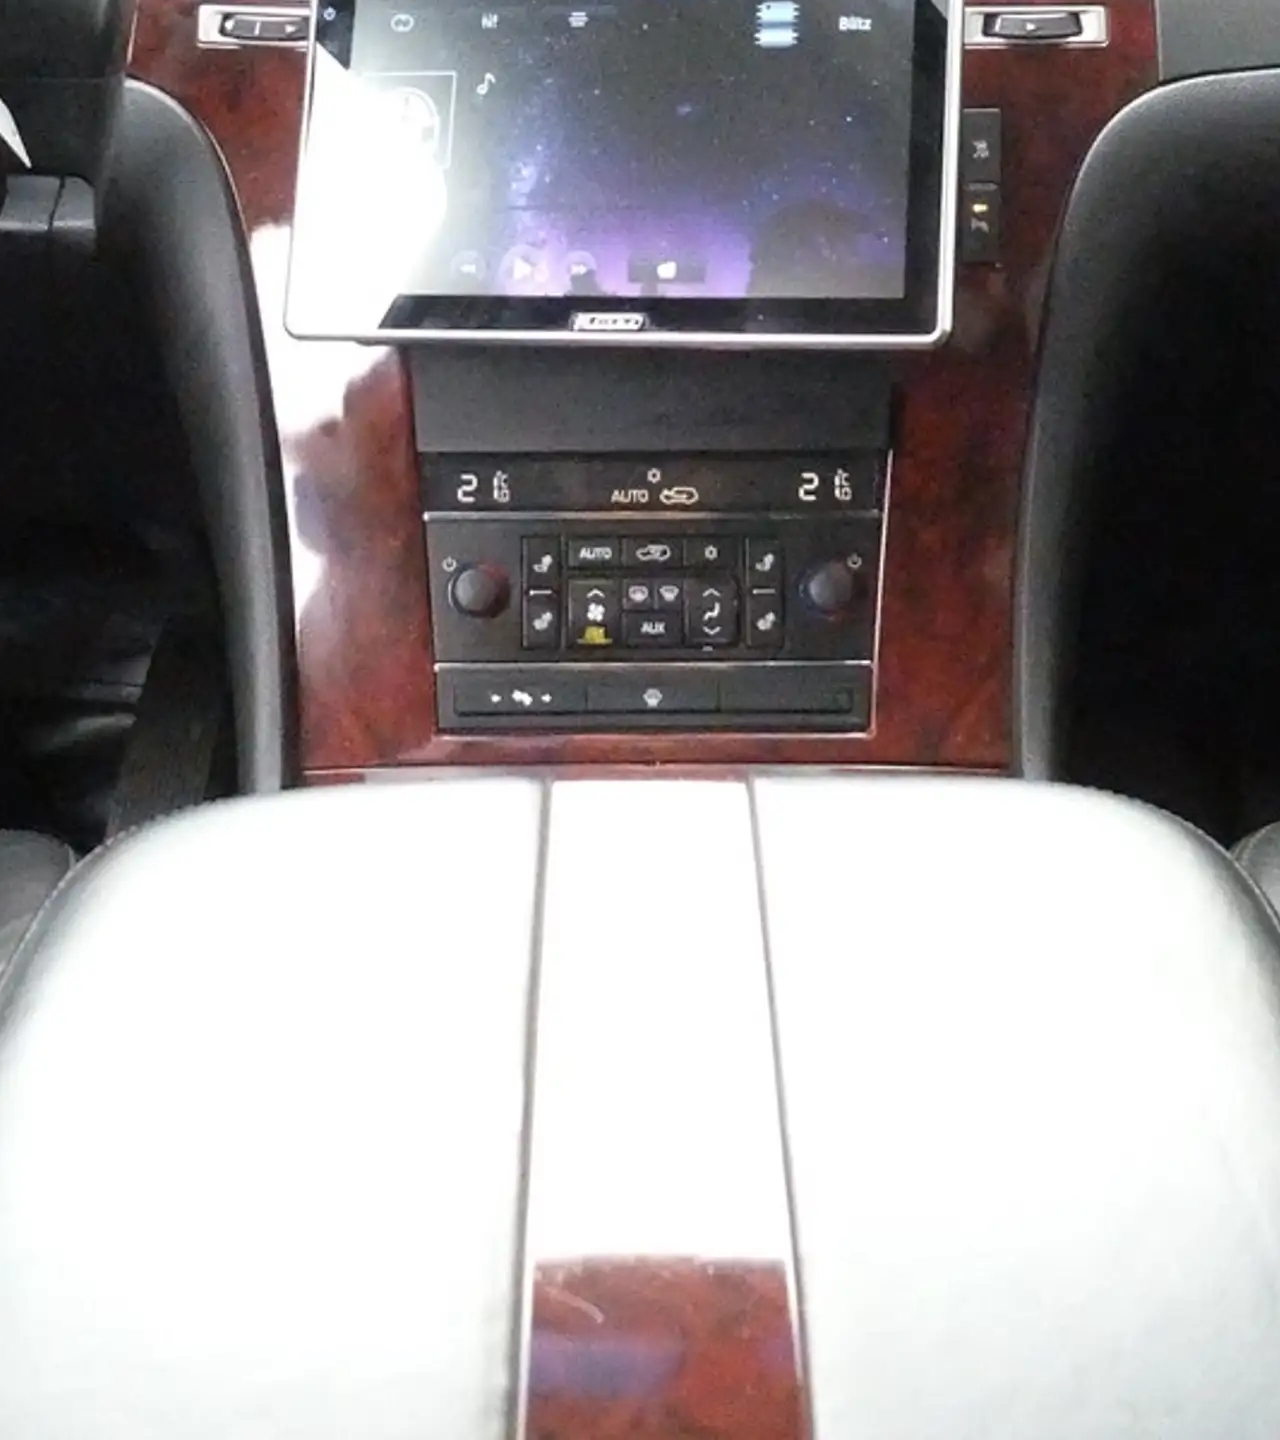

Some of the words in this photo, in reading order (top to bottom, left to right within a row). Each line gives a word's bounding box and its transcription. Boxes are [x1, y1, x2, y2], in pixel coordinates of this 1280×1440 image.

[610, 489, 649, 504] AUTO
[579, 546, 613, 561] AUTO
[640, 621, 666, 634] AUX
